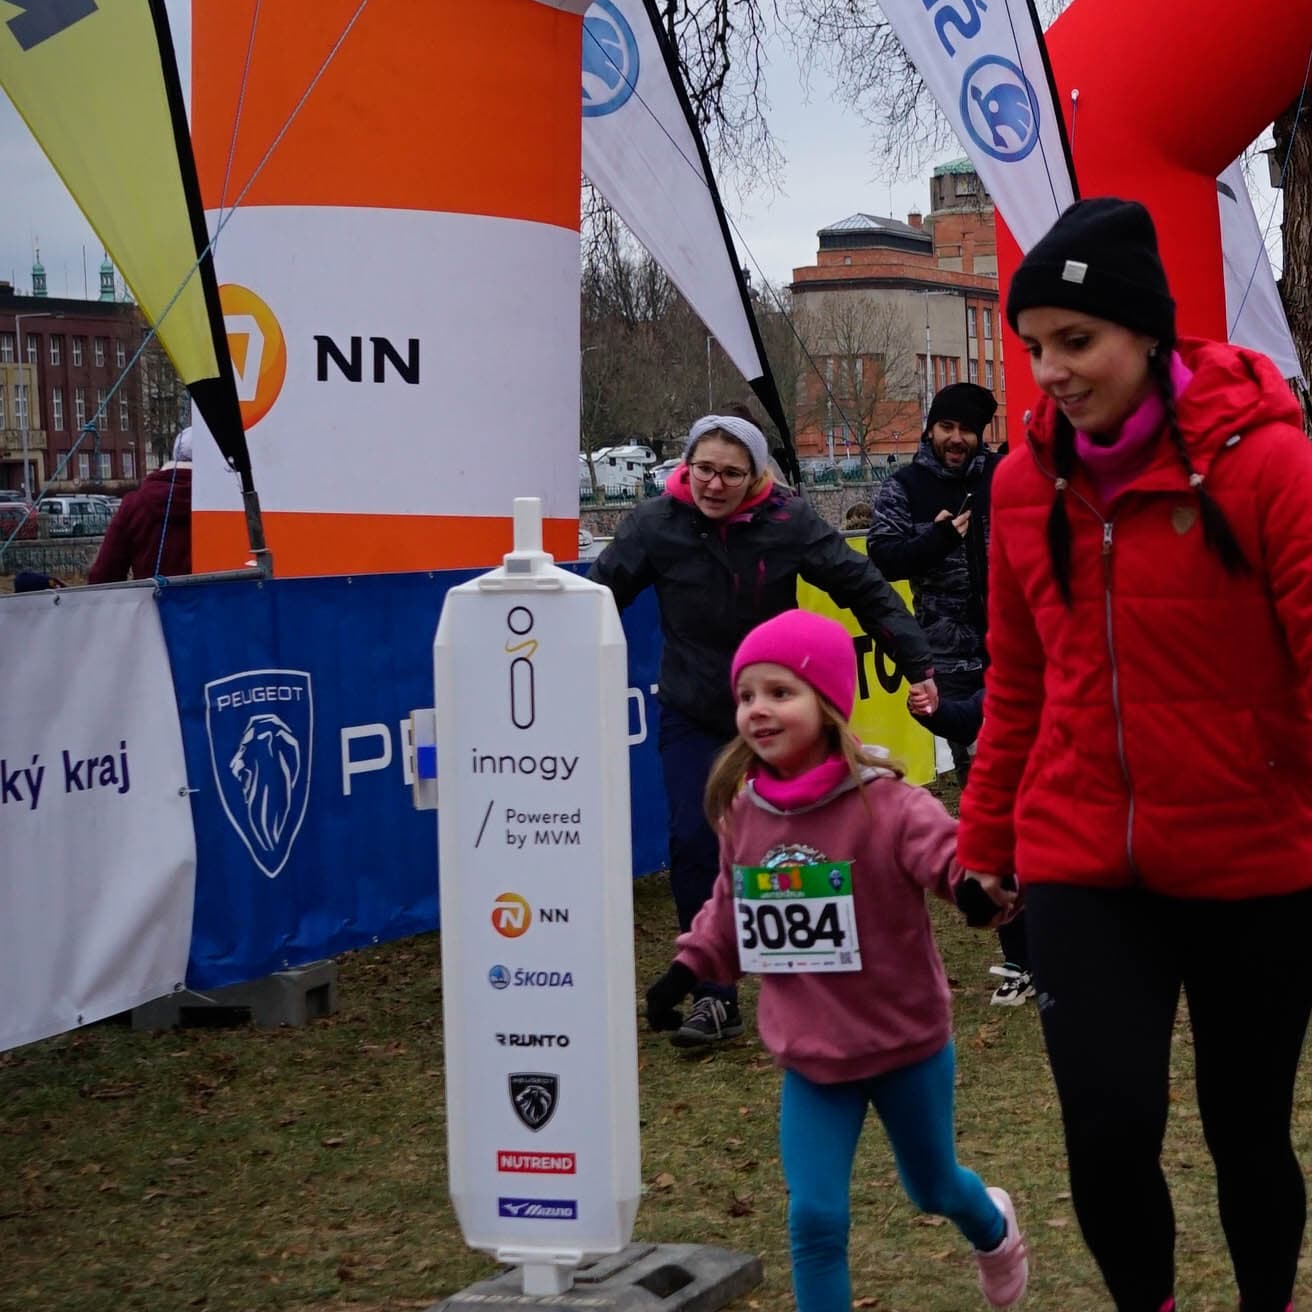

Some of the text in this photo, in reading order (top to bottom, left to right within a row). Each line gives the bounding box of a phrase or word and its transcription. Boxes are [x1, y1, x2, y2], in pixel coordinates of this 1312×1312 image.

[313, 335, 420, 385] NN
[217, 686, 304, 712] PEUGEOT
[62, 740, 131, 794] kraj
[472, 748, 579, 780] innogy
[506, 809, 581, 824] Powered
[506, 830, 581, 849] by MVM
[540, 908, 569, 923] NN
[738, 902, 845, 950] 3084
[514, 968, 574, 987] ŠKODA
[501, 1155, 573, 1170] NUTREND
